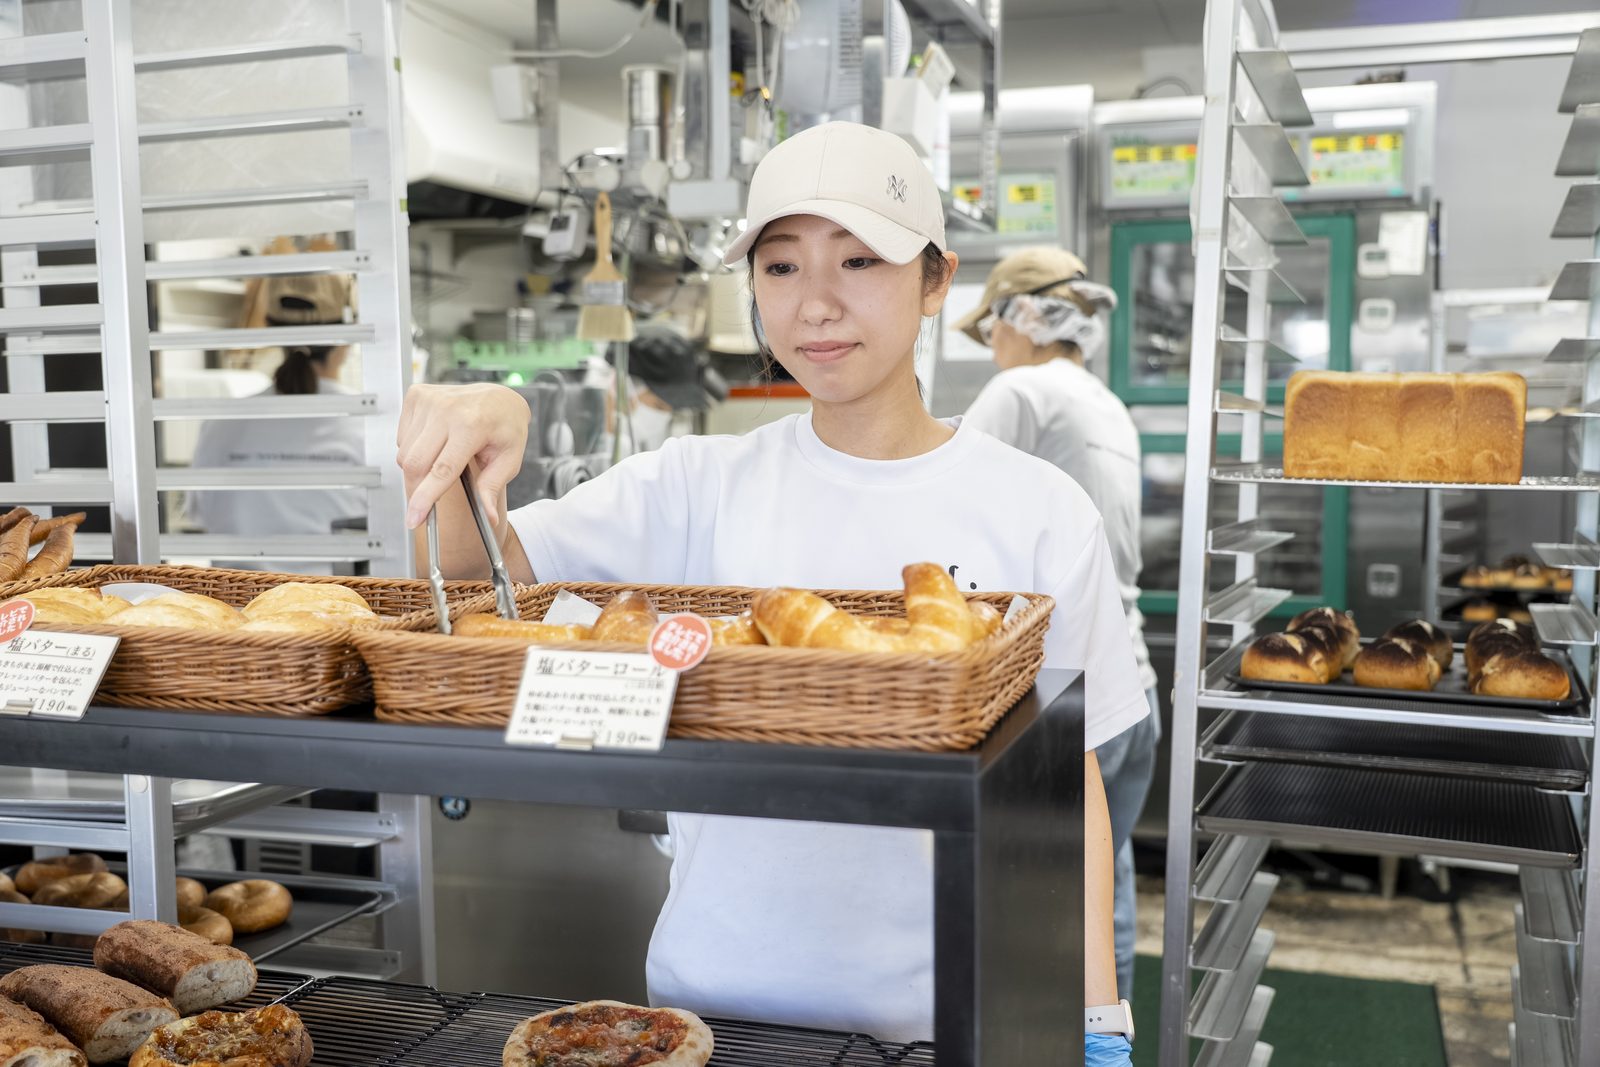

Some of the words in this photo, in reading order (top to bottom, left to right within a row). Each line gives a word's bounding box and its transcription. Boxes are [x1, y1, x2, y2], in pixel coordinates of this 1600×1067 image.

[886, 175, 908, 203] NY
[537, 656, 665, 678] 塩バターロール
